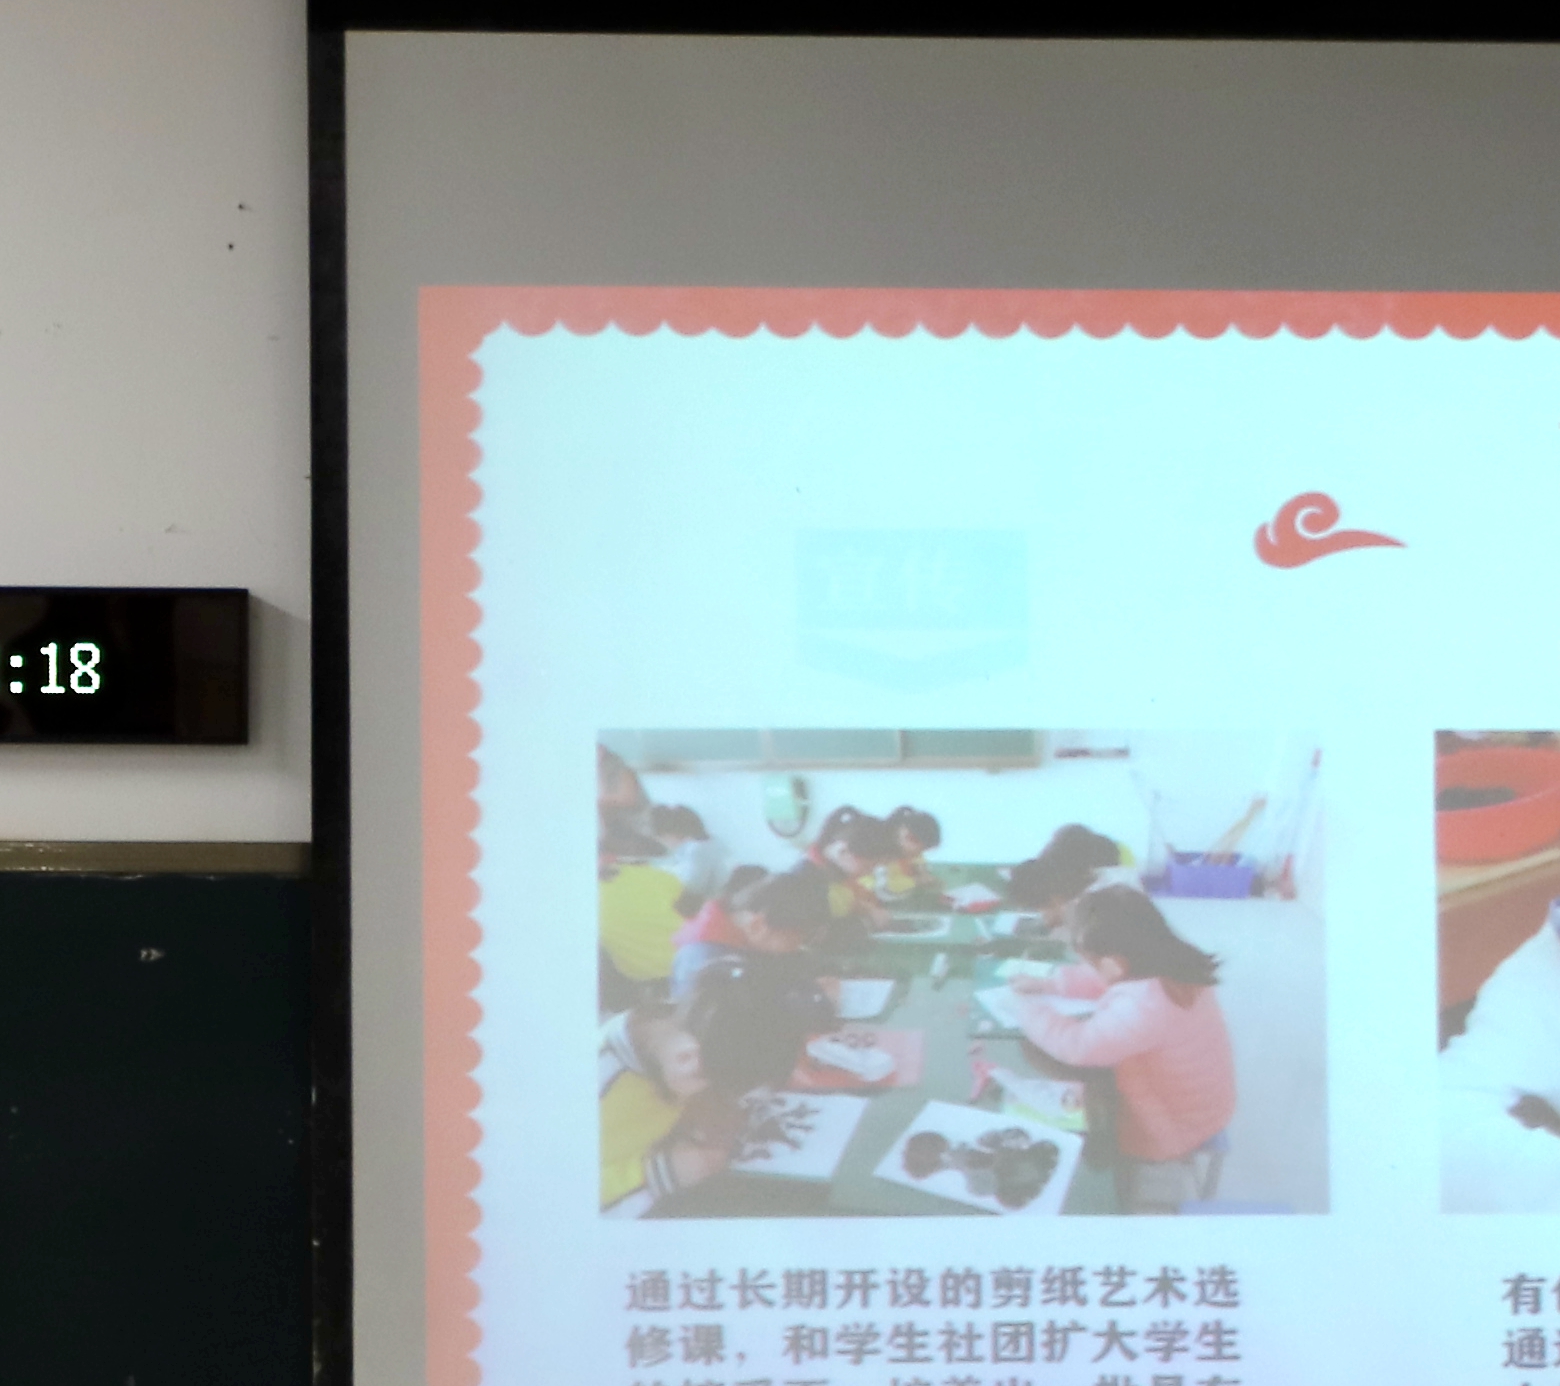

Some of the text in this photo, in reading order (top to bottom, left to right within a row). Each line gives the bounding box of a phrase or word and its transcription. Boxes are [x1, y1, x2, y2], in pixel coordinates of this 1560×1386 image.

[625, 1266, 1241, 1312] 通过长期开设的剪纸艺术选
